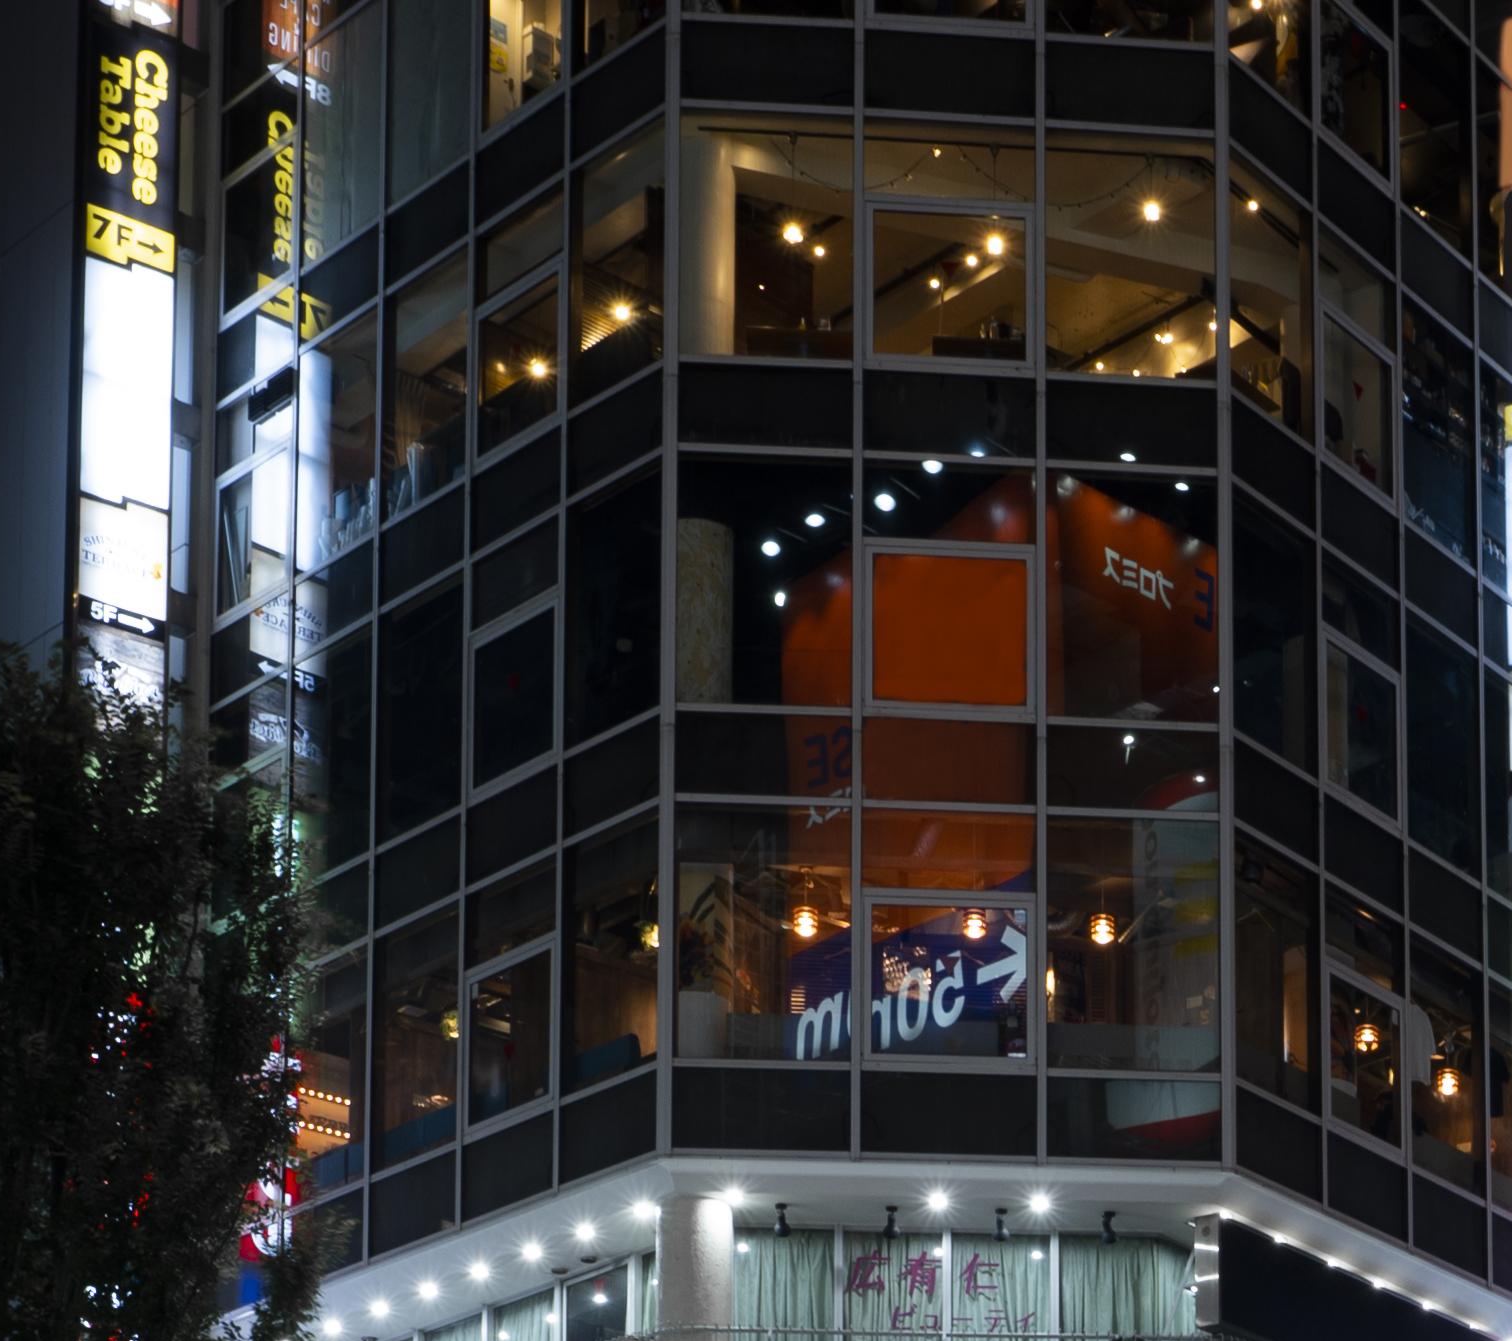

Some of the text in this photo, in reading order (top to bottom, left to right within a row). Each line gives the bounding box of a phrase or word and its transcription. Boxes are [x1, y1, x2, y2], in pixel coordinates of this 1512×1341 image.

[98, 55, 133, 175] Table
[132, 49, 169, 205] Cheese
[92, 212, 136, 247] 7F
[90, 601, 117, 624] 5F
